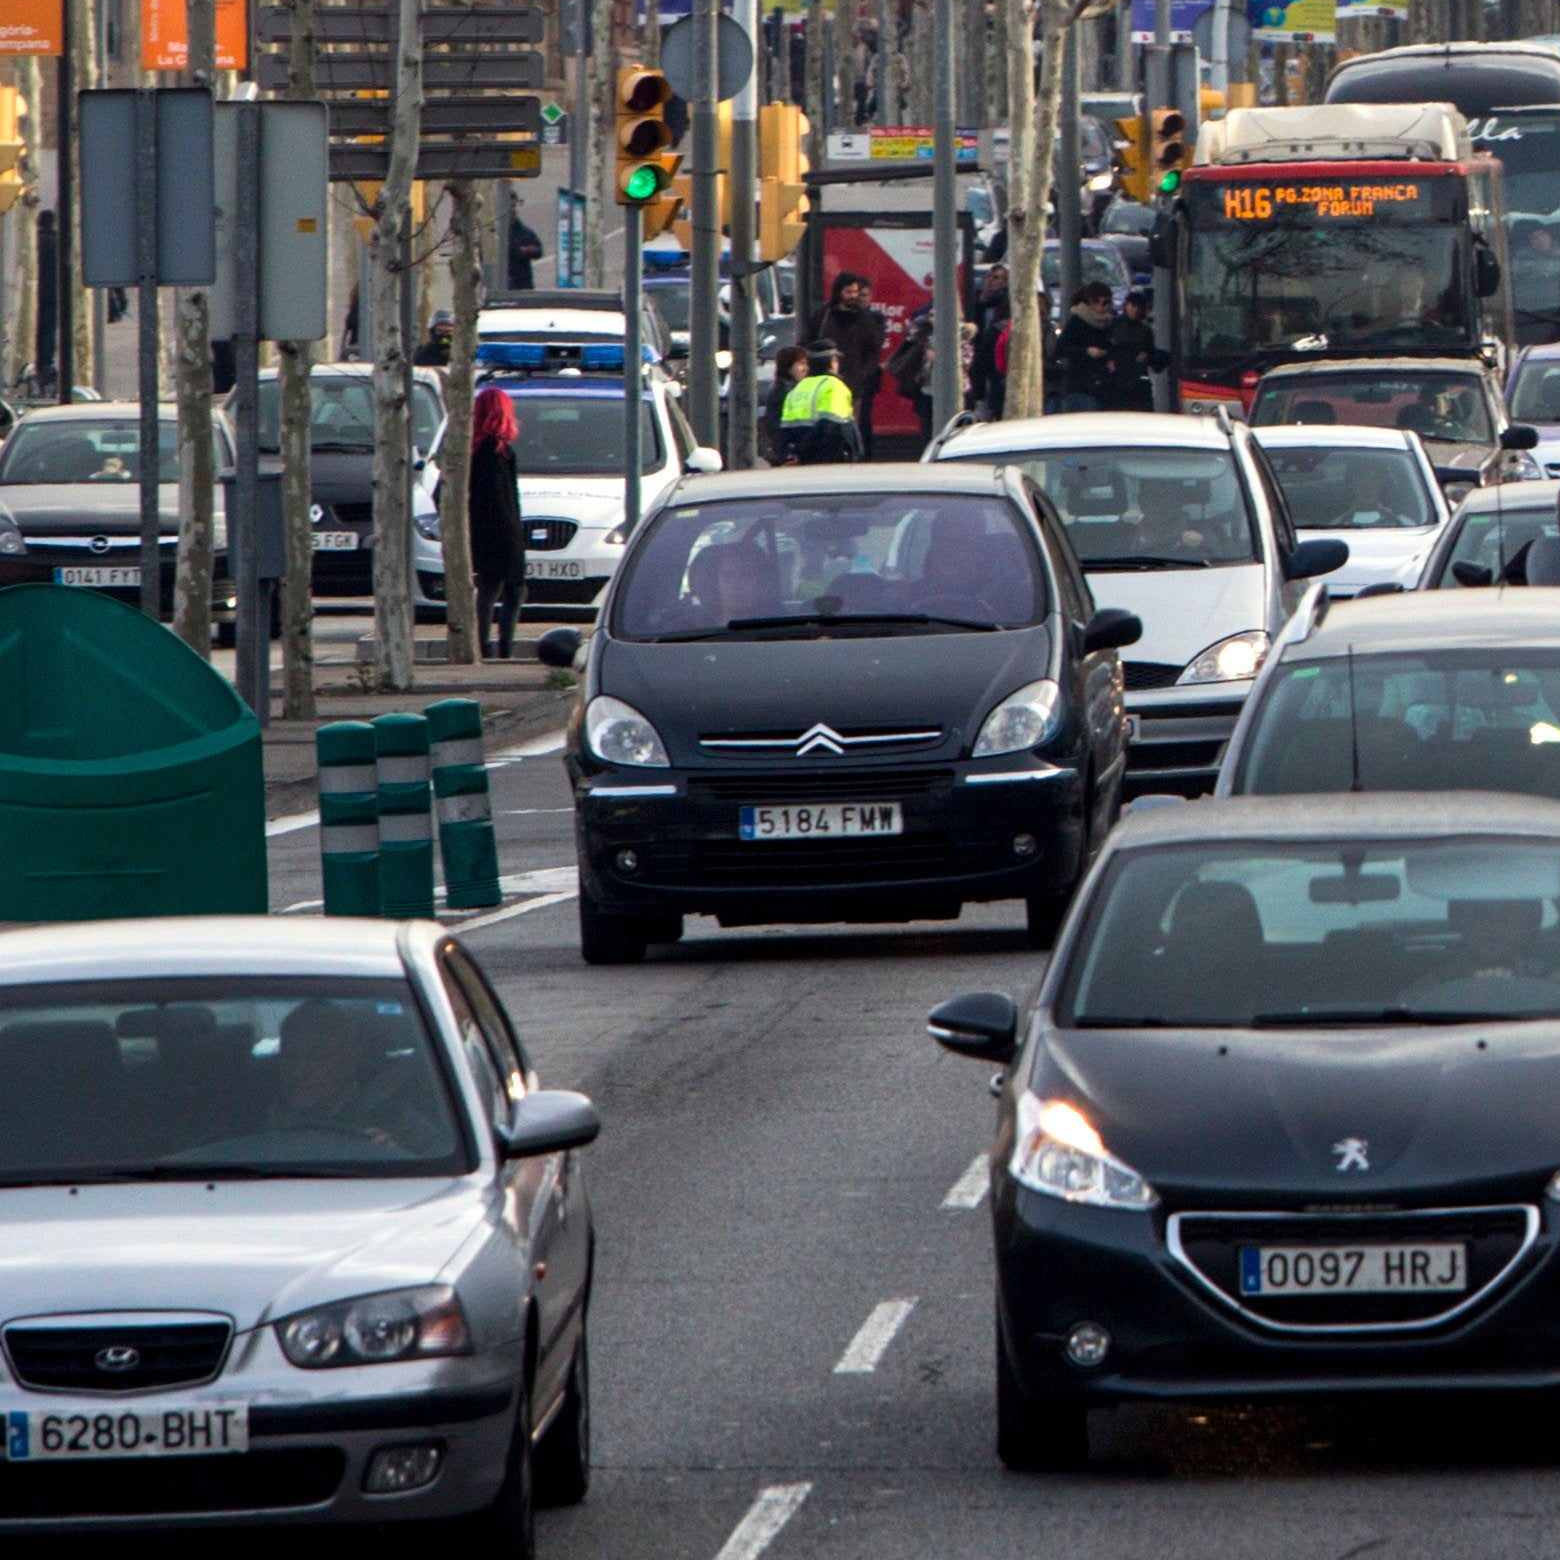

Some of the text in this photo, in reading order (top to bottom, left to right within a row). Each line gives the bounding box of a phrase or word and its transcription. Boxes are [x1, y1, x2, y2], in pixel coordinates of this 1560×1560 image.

[1224, 188, 1273, 219] H16
[1317, 200, 1374, 217] FORUM
[758, 805, 894, 835] 5184 FMW
[1267, 1249, 1458, 1287] 0097 HRJ
